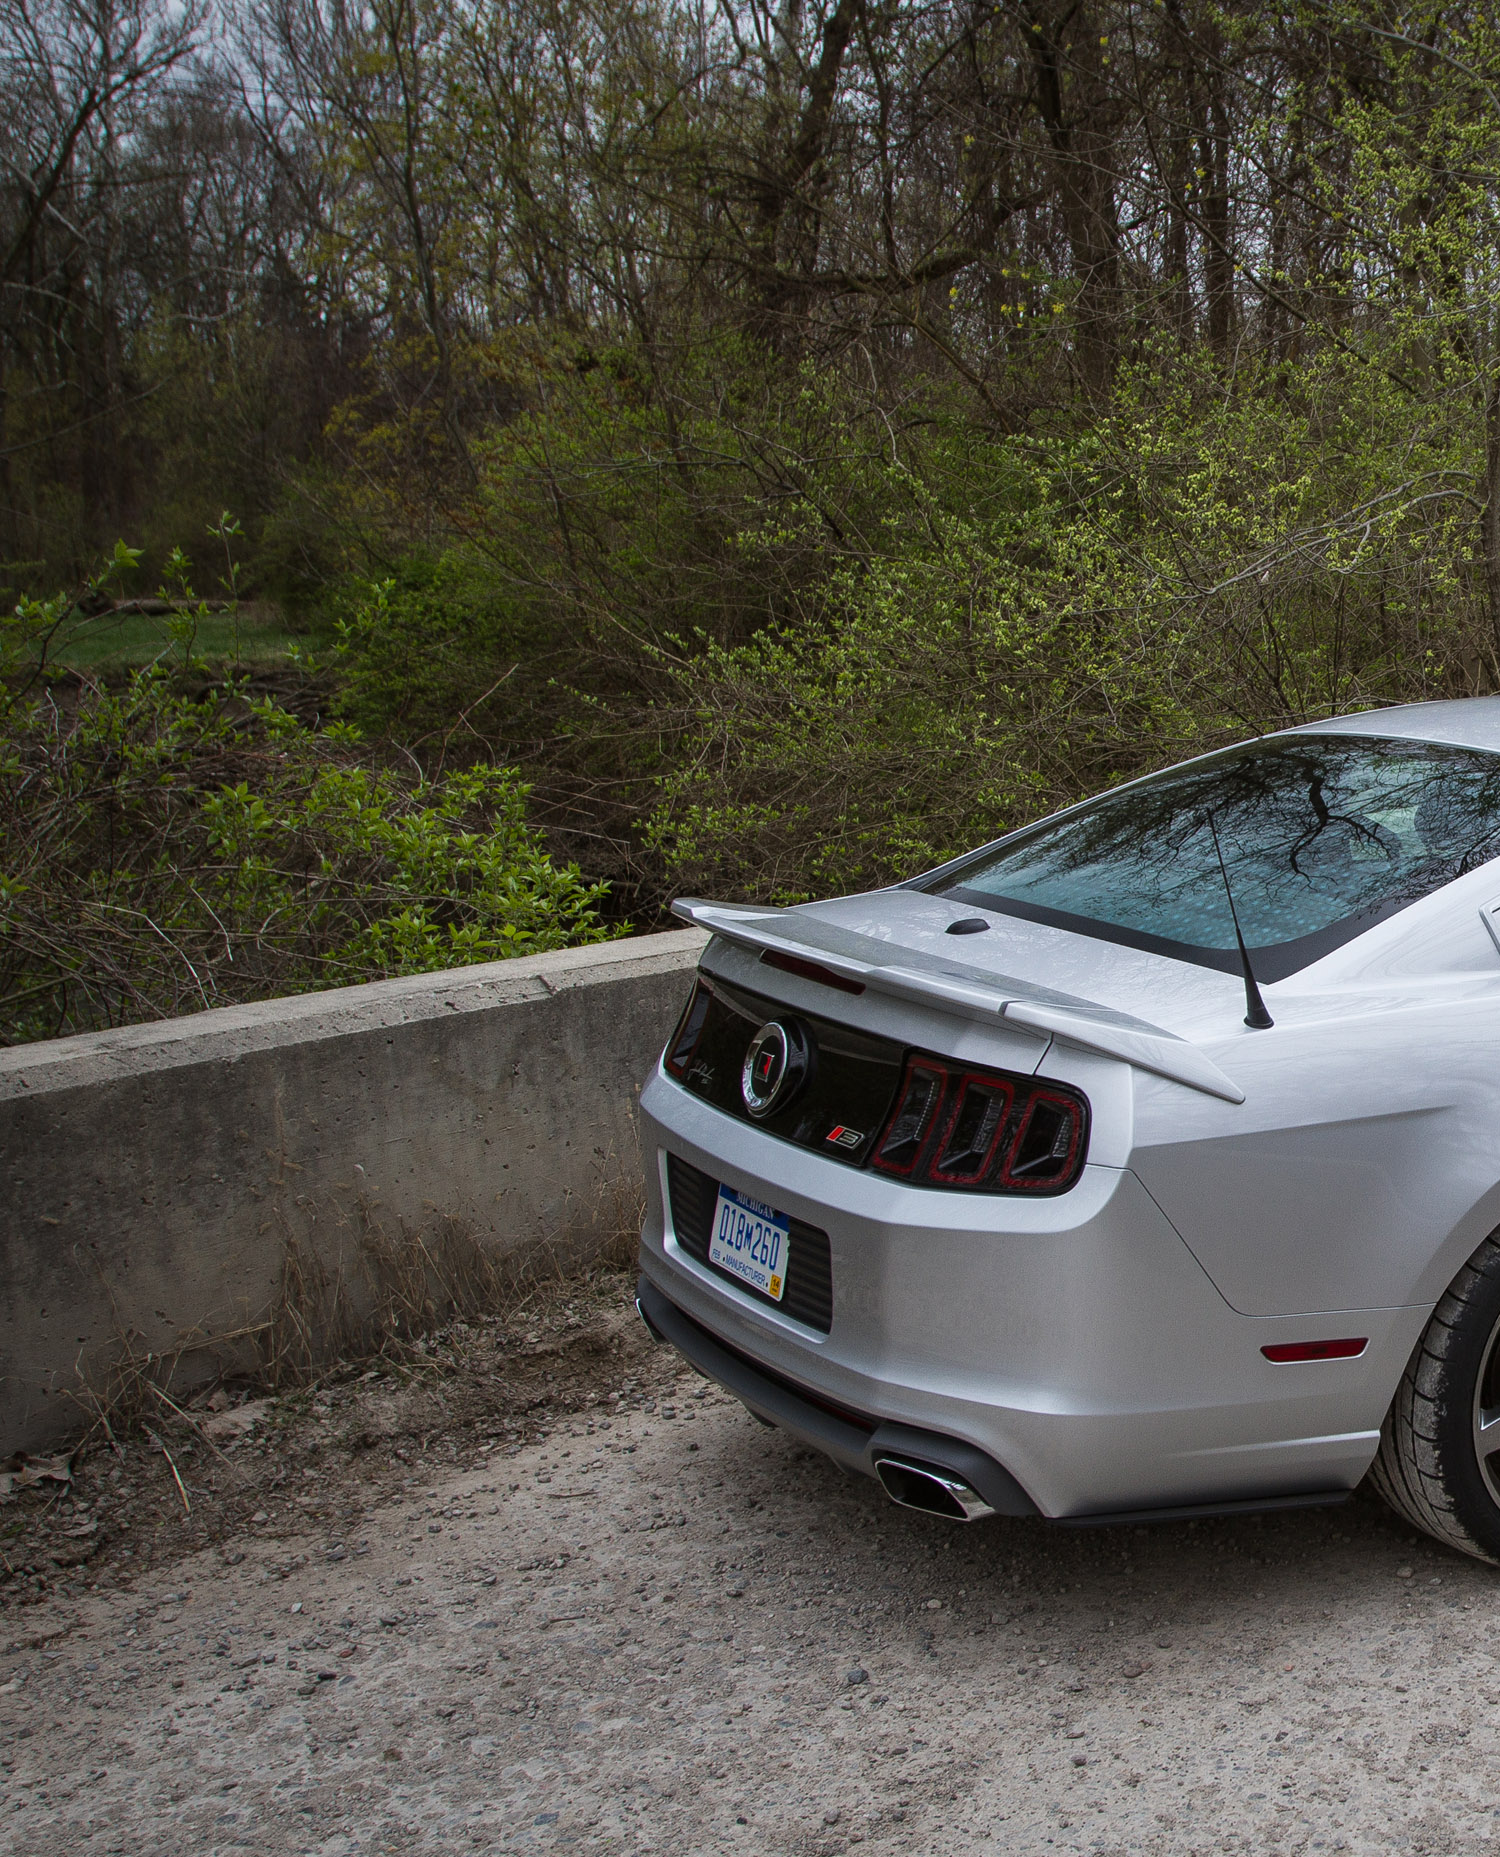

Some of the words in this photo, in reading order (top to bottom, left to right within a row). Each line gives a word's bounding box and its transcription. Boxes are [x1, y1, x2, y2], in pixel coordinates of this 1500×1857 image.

[736, 1192, 774, 1220] MICHIGAN
[719, 1203, 780, 1271] 018M260
[725, 1254, 765, 1287] MANUFACTURER
